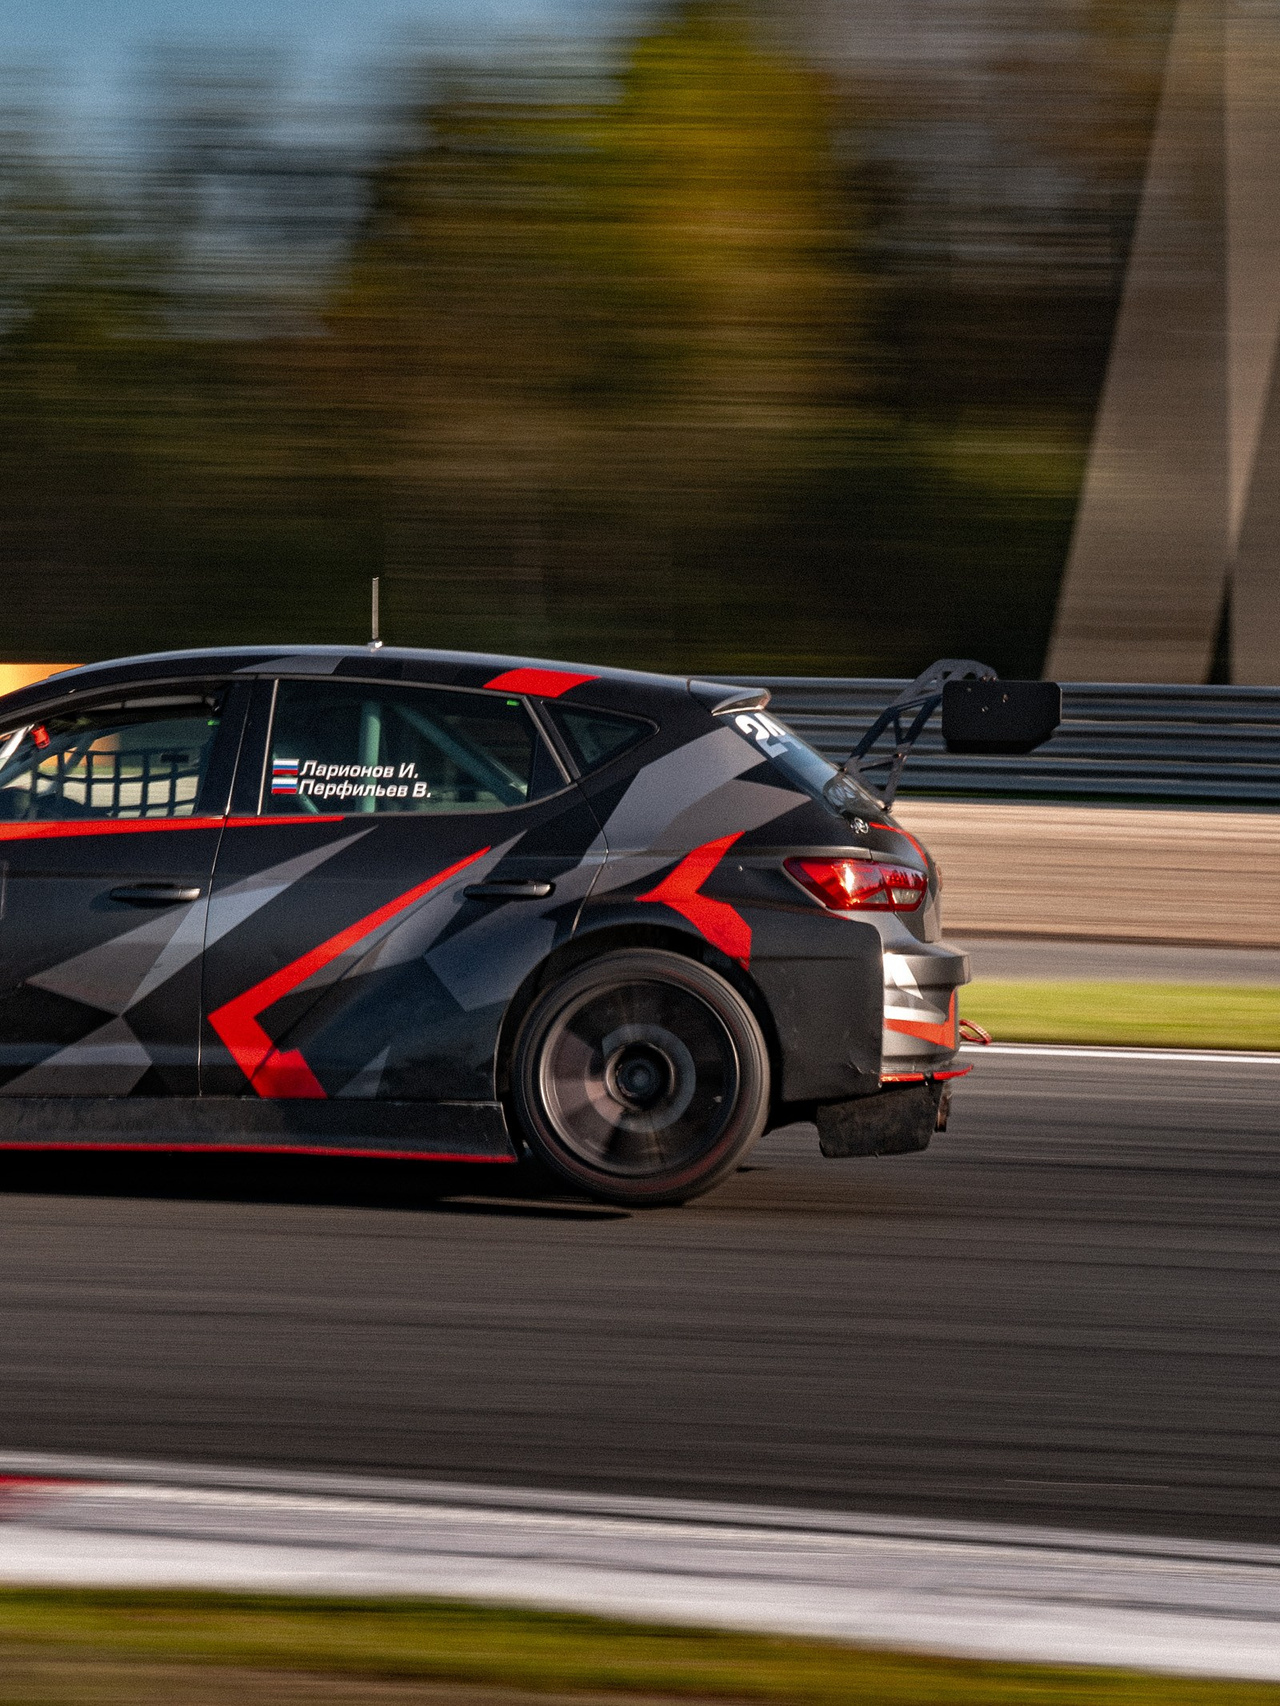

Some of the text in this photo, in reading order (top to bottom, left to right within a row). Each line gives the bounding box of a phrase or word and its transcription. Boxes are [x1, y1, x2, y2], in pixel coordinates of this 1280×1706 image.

[300, 760, 419, 779] Ларионов И.
[298, 779, 432, 799] Перфильев В.
